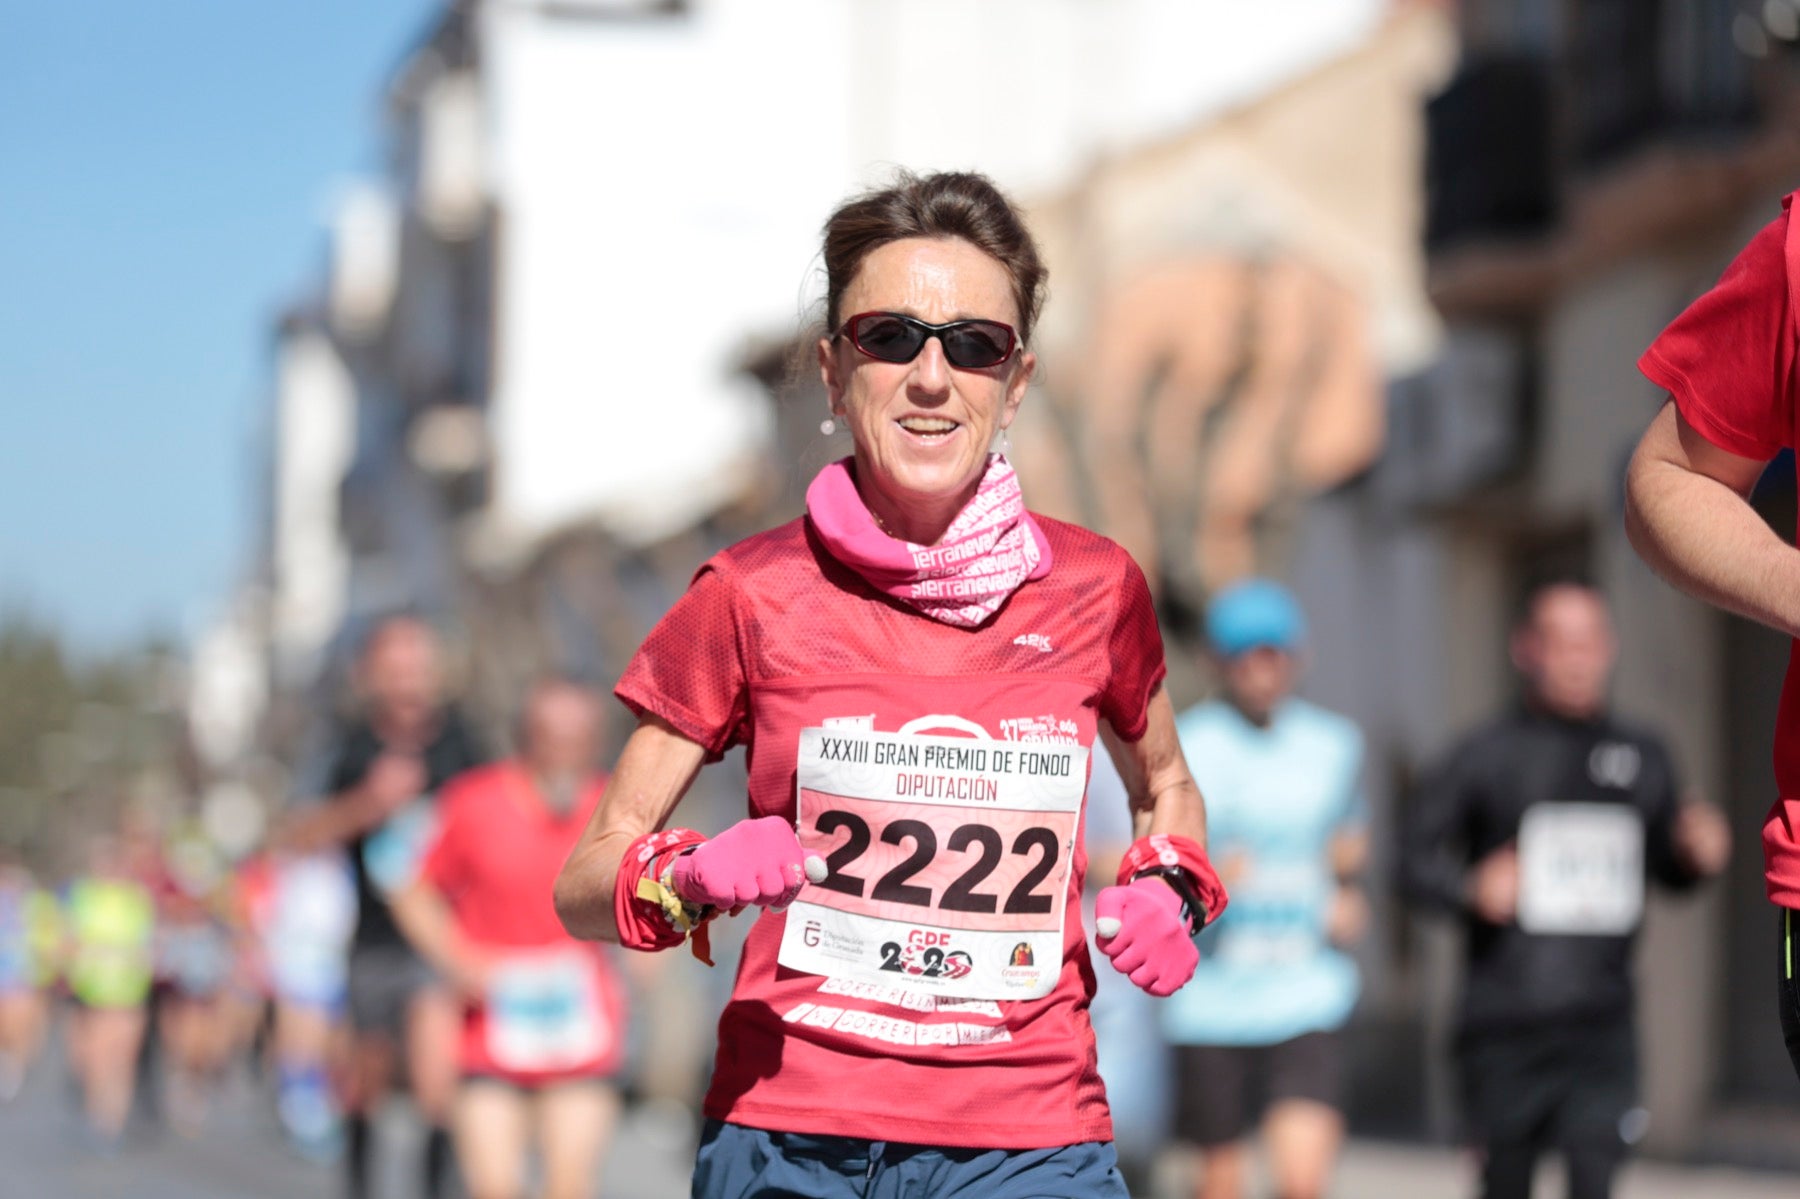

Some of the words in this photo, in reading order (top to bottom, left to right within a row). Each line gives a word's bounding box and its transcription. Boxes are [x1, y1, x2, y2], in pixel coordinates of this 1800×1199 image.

[820, 737, 868, 763] XXXIII
[875, 742, 919, 767] GRAN
[924, 745, 986, 771] PREMIO
[992, 750, 1013, 773] DE
[1018, 752, 1071, 777] FONDO
[896, 772, 998, 801] DIPUTACIÓN
[809, 809, 1059, 915] 2222
